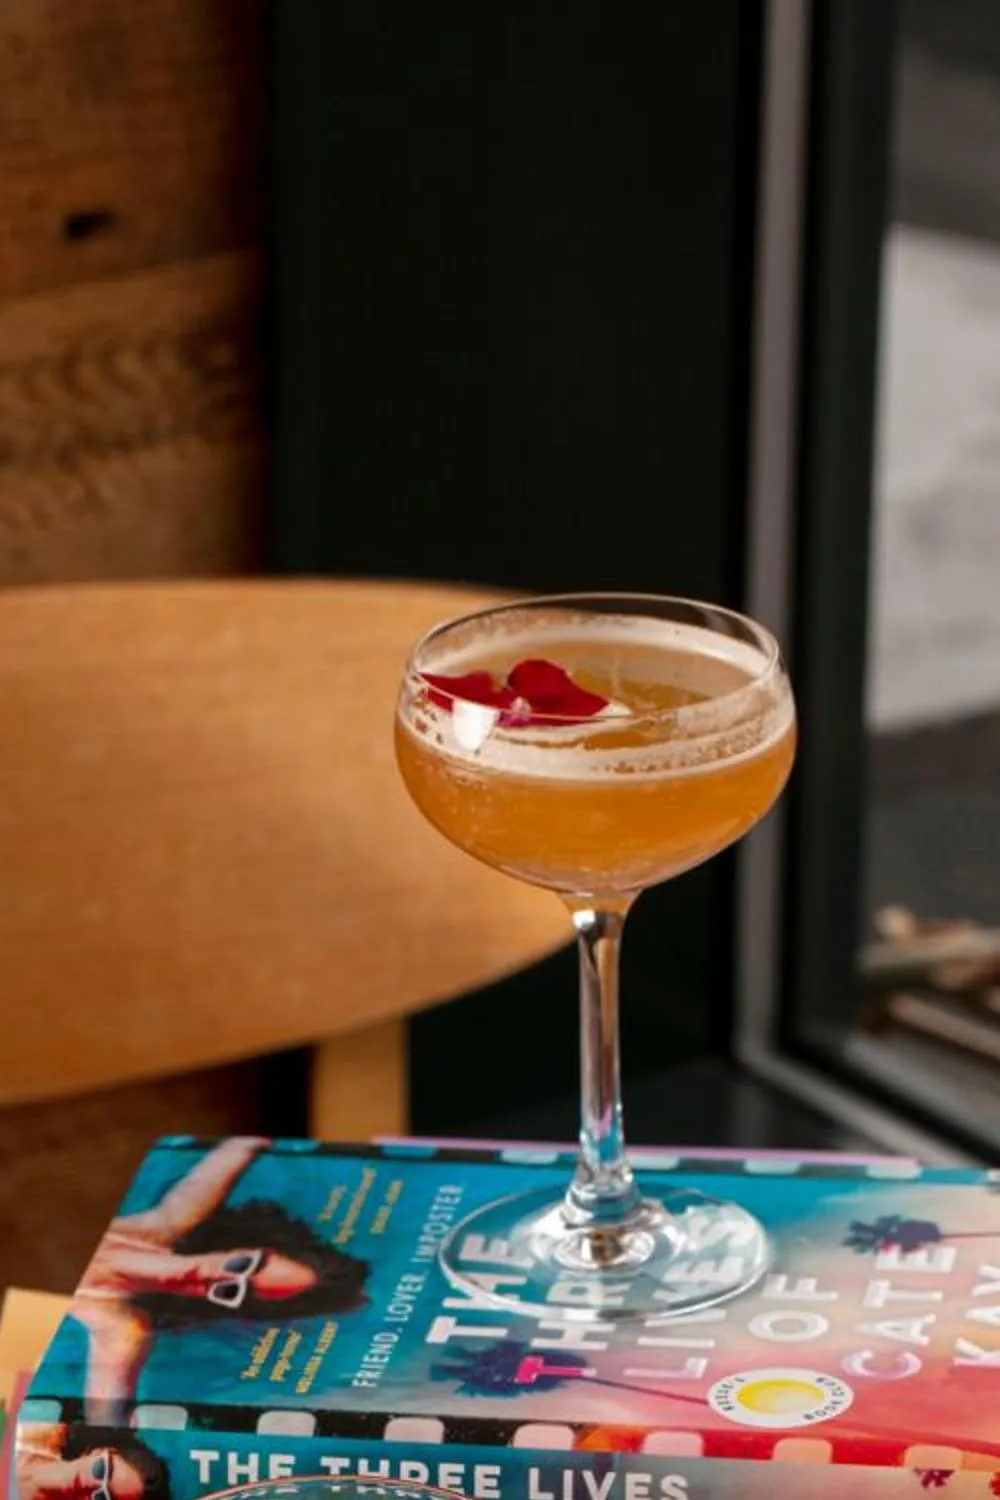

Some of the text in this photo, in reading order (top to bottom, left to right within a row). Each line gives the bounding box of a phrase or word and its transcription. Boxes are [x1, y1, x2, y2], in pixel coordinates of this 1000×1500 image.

[424, 1232, 537, 1344] THE
[748, 1273, 839, 1343] OF
[840, 1245, 958, 1381] CATE
[189, 1449, 297, 1485] THE
[320, 1456, 502, 1499] THREE
